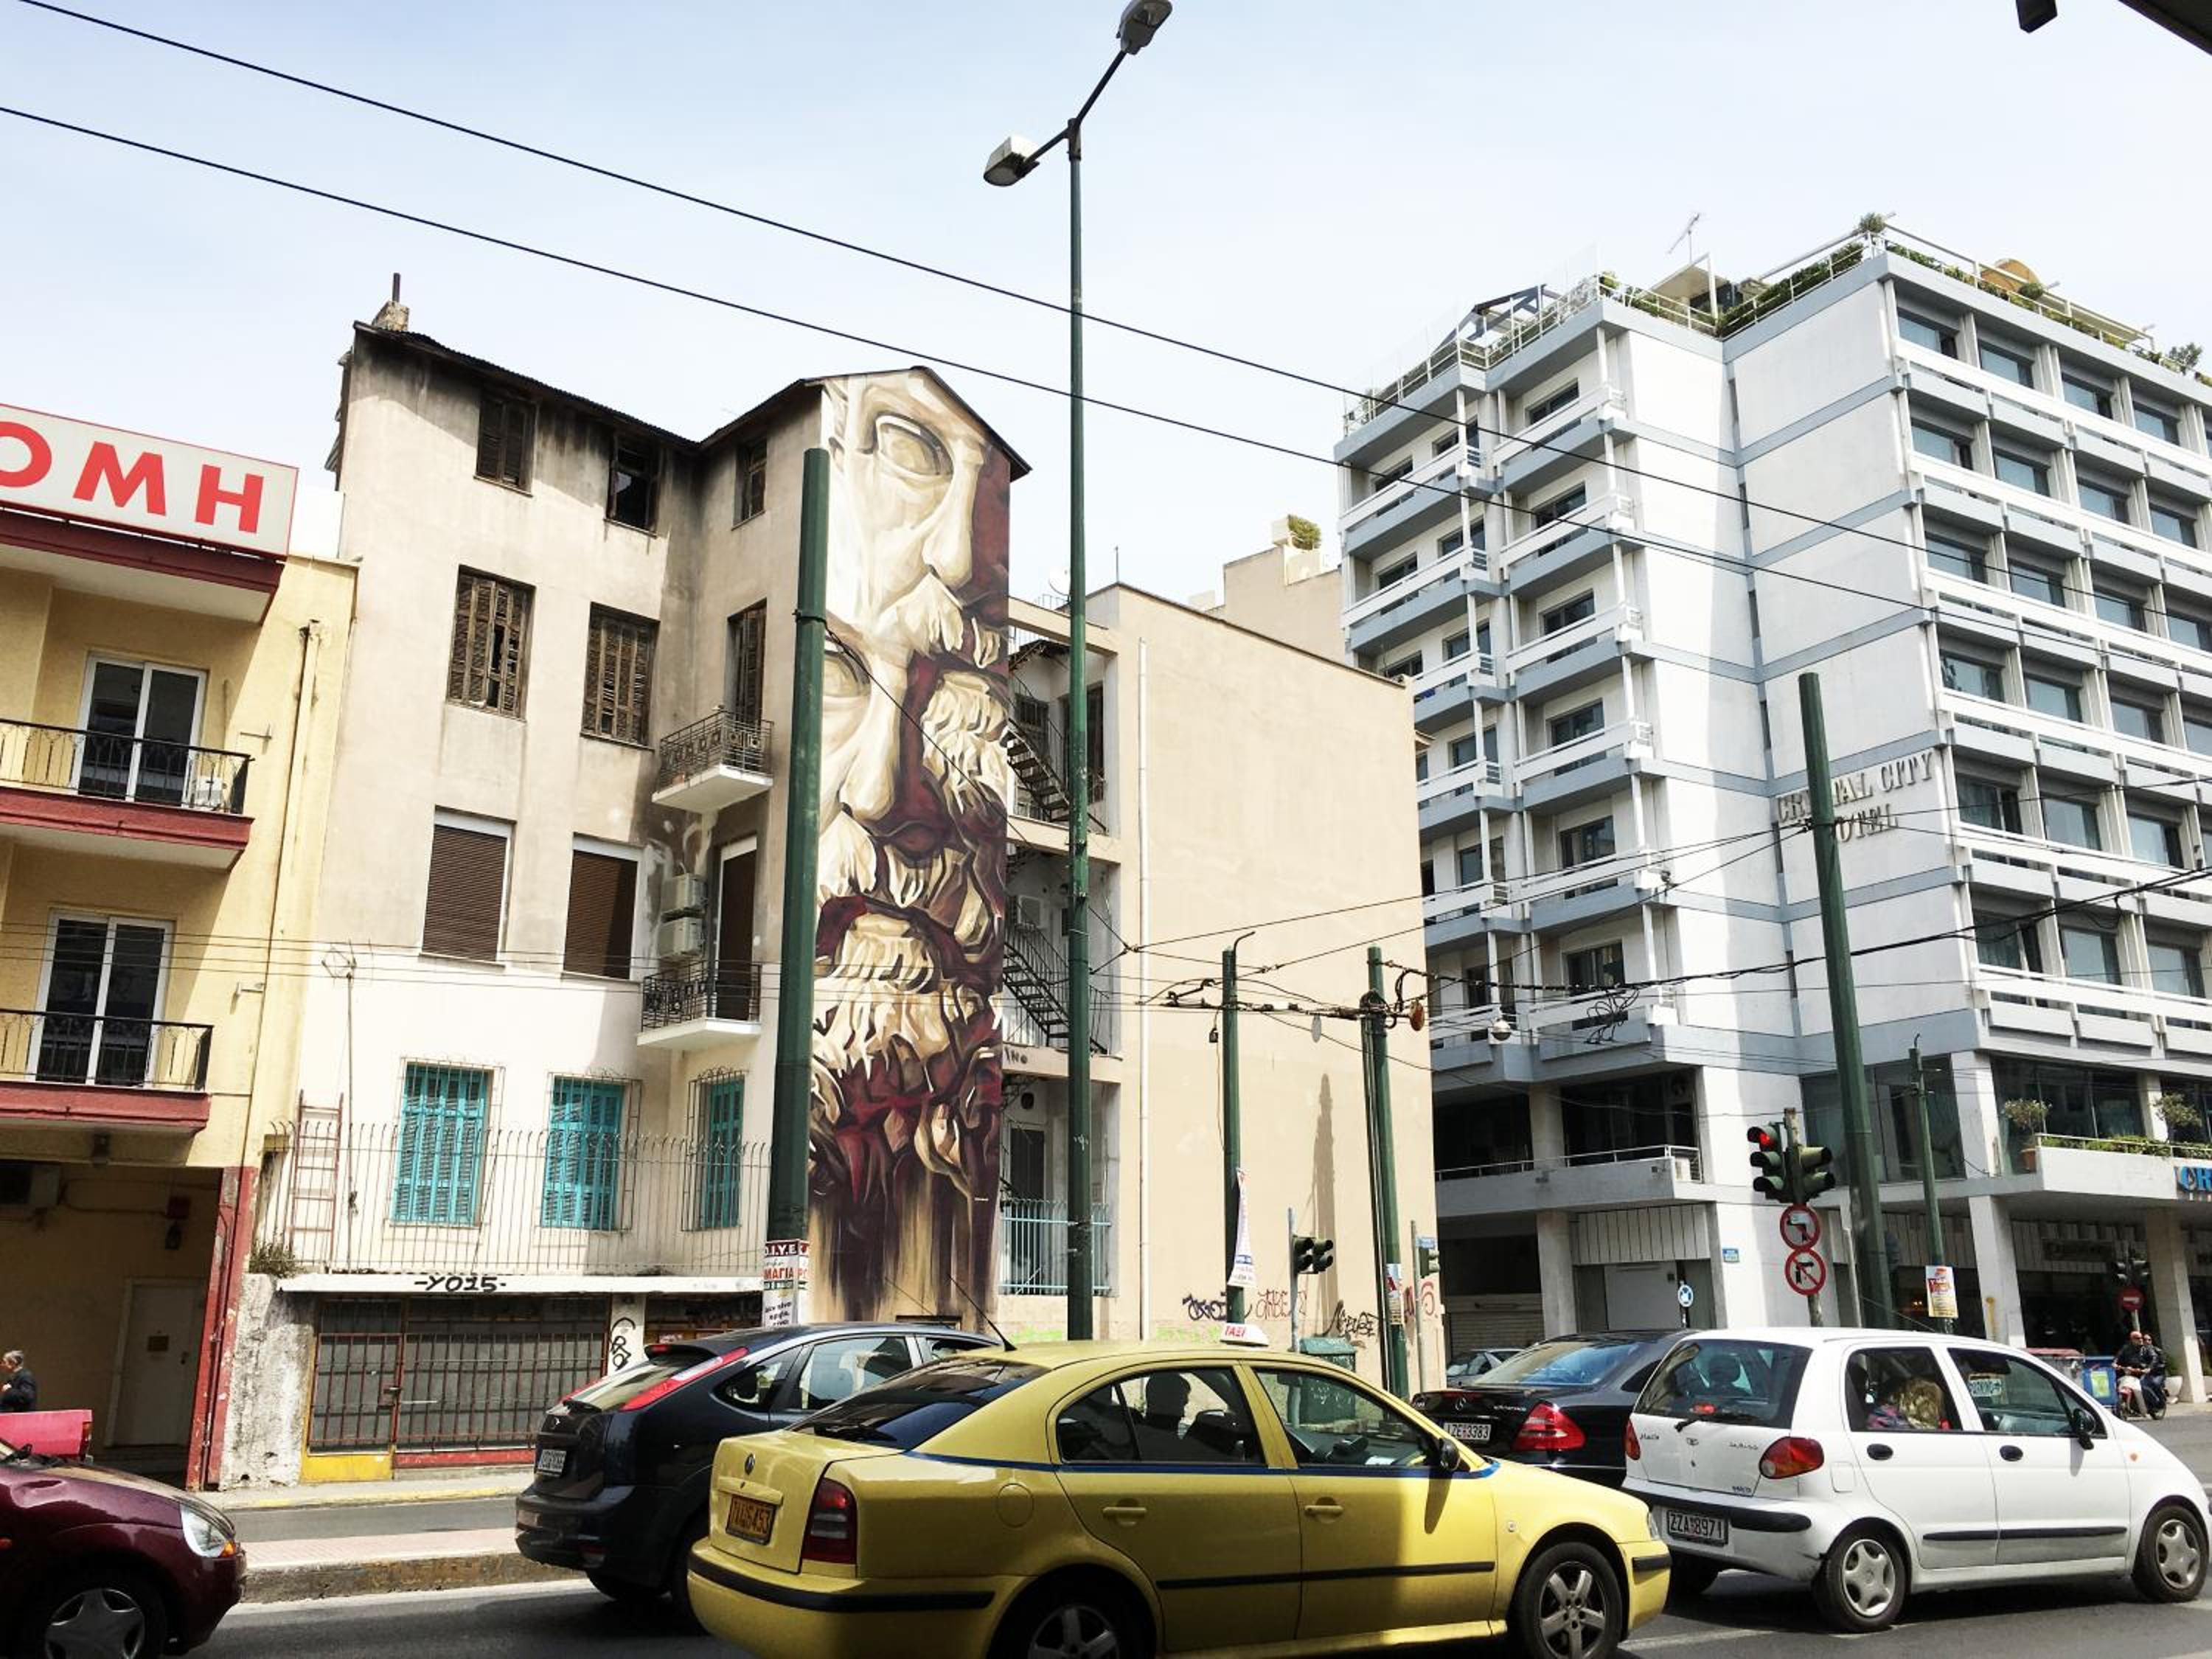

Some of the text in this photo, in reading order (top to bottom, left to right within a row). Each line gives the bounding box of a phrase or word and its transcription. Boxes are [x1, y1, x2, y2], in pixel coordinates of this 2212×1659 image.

[1777, 752, 1932, 823] CRTAL CITY
[1834, 803, 1899, 842] OTEL
